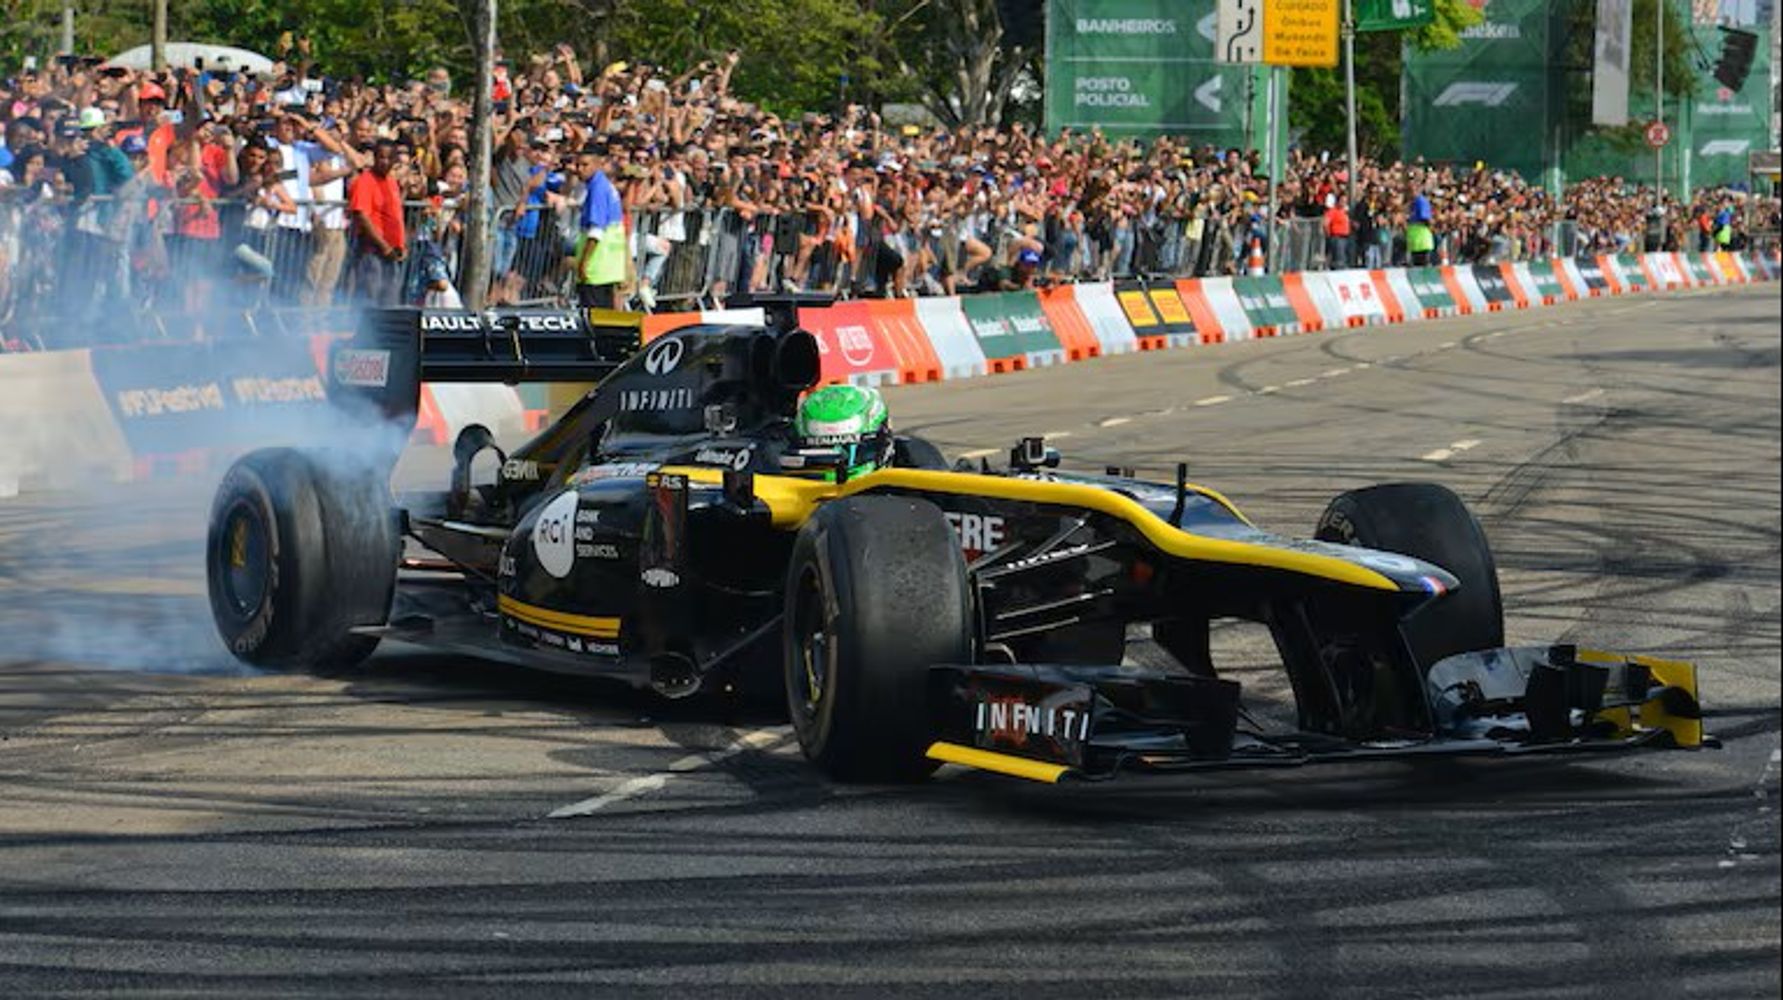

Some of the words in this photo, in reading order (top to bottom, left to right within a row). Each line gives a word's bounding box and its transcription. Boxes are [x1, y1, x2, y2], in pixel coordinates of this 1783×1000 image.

[1076, 18, 1176, 34] BANHEIROS
[1075, 77, 1131, 91] POSTO
[1075, 93, 1150, 106] POLICIAL
[620, 388, 692, 411] INFINITI
[976, 702, 1089, 741] INFNITI
